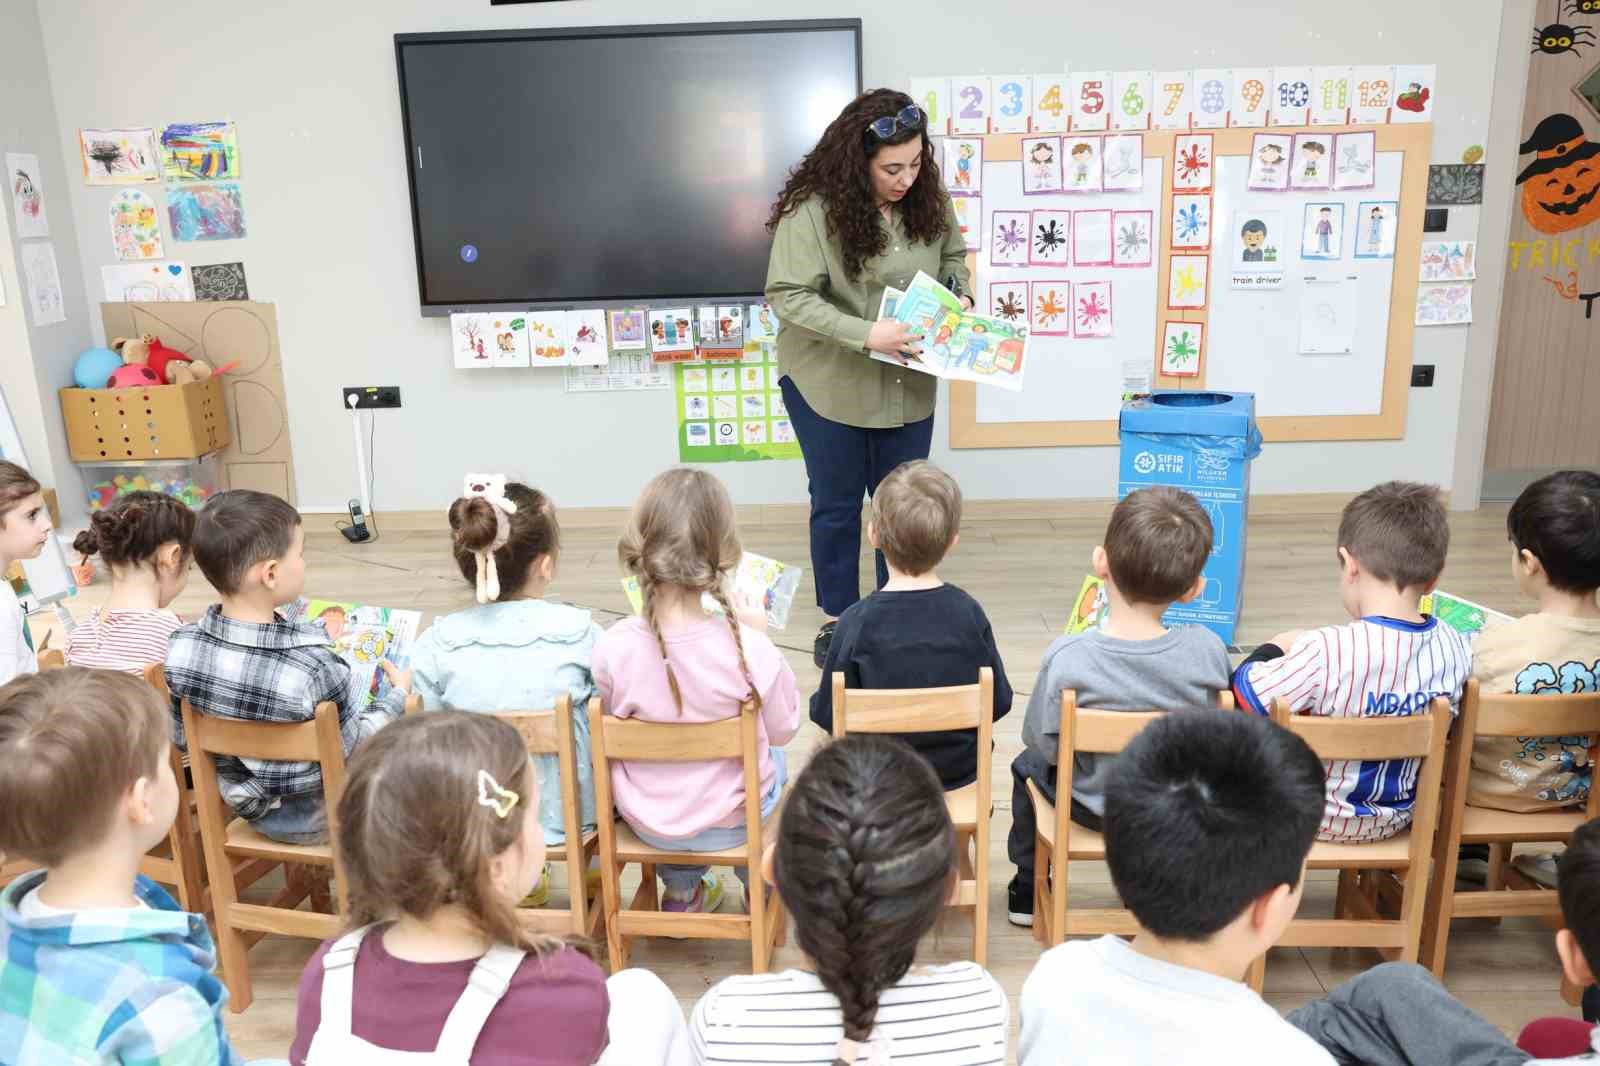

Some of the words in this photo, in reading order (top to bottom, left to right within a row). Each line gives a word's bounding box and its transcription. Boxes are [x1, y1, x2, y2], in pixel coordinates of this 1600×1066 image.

[925, 90, 937, 124] 1
[959, 86, 984, 119] 2
[1000, 82, 1023, 116] 3
[1039, 84, 1064, 117] 4
[1081, 81, 1104, 114] 5
[1121, 82, 1144, 116] 6
[1163, 83, 1184, 116] 7
[1200, 79, 1225, 113] 8
[1241, 79, 1265, 112] 9
[1277, 81, 1309, 107] 10
[1320, 79, 1346, 111] 11
[1358, 80, 1388, 107] 12
[1233, 275, 1253, 284] train
[1256, 275, 1281, 284] driver
[1157, 454, 1184, 464] SIFIR
[1157, 464, 1184, 473] ATIK
